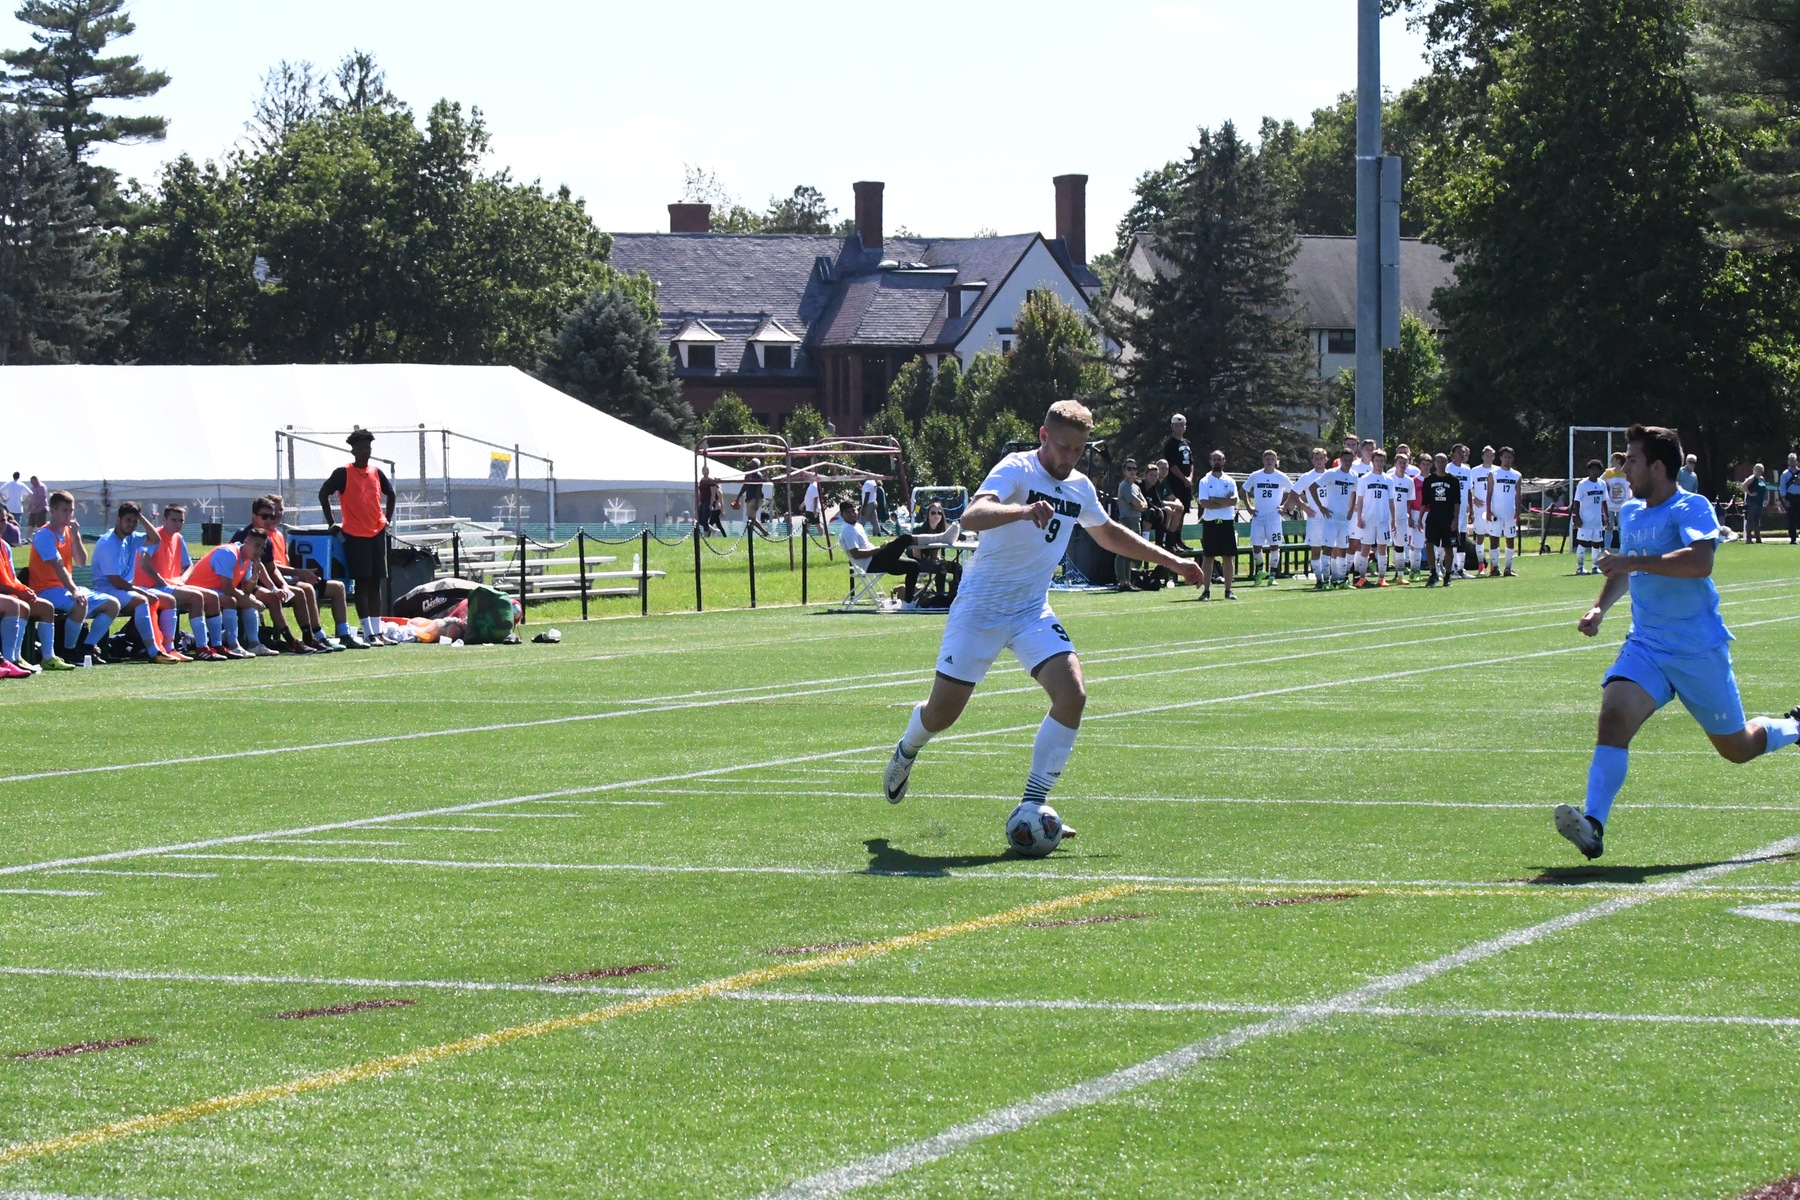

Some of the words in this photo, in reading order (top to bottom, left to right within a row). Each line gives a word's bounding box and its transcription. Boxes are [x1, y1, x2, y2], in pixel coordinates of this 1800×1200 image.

[1503, 485, 1510, 493] 17
[1262, 490, 1272, 498] 26
[1374, 490, 1382, 498] 18
[1397, 493, 1402, 502] 2
[1045, 518, 1061, 543] 9
[1272, 533, 1281, 541] 26
